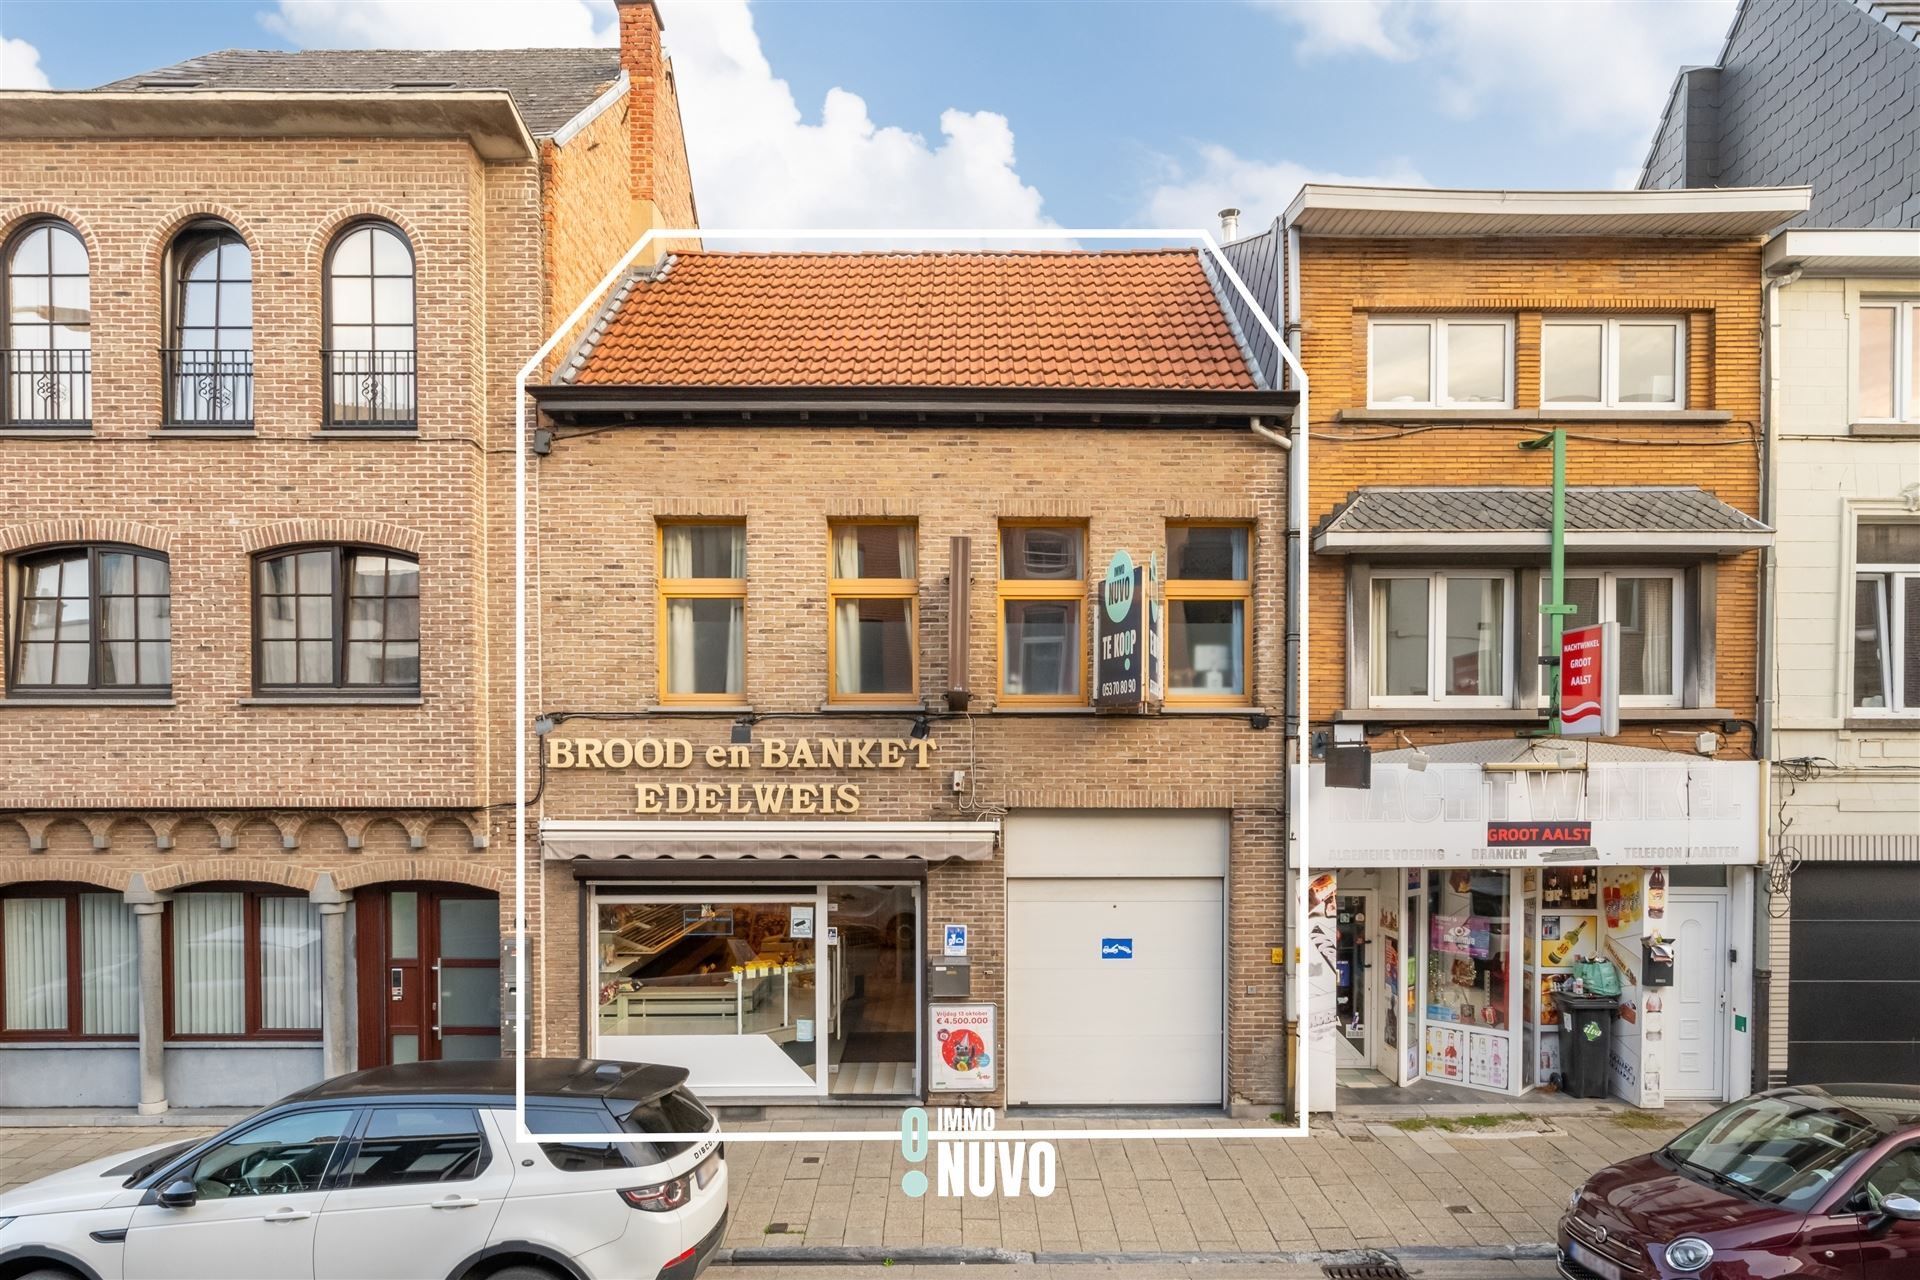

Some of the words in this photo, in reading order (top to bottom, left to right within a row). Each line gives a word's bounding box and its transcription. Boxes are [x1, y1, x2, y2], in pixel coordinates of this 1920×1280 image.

[1108, 576, 1130, 606] NUVO
[1102, 635, 1112, 660] TE
[1113, 629, 1137, 658] KOOP
[1563, 639, 1600, 652] NACHTWINKEL
[1570, 657, 1591, 669] GROOT
[1102, 681, 1112, 697] 053
[1113, 681, 1120, 696] 70
[1120, 680, 1128, 695] 80
[1128, 678, 1136, 694] 90
[1570, 675, 1592, 687] AALST
[547, 738, 693, 768] BROOD
[705, 744, 750, 768] en
[761, 738, 938, 768] BANKET
[635, 783, 860, 813] EDELWEIS
[1488, 828, 1539, 841] GROOT
[1542, 828, 1591, 841] AALST
[1472, 849, 1528, 860] DRANKEN
[1624, 847, 1681, 859] TELEFOON
